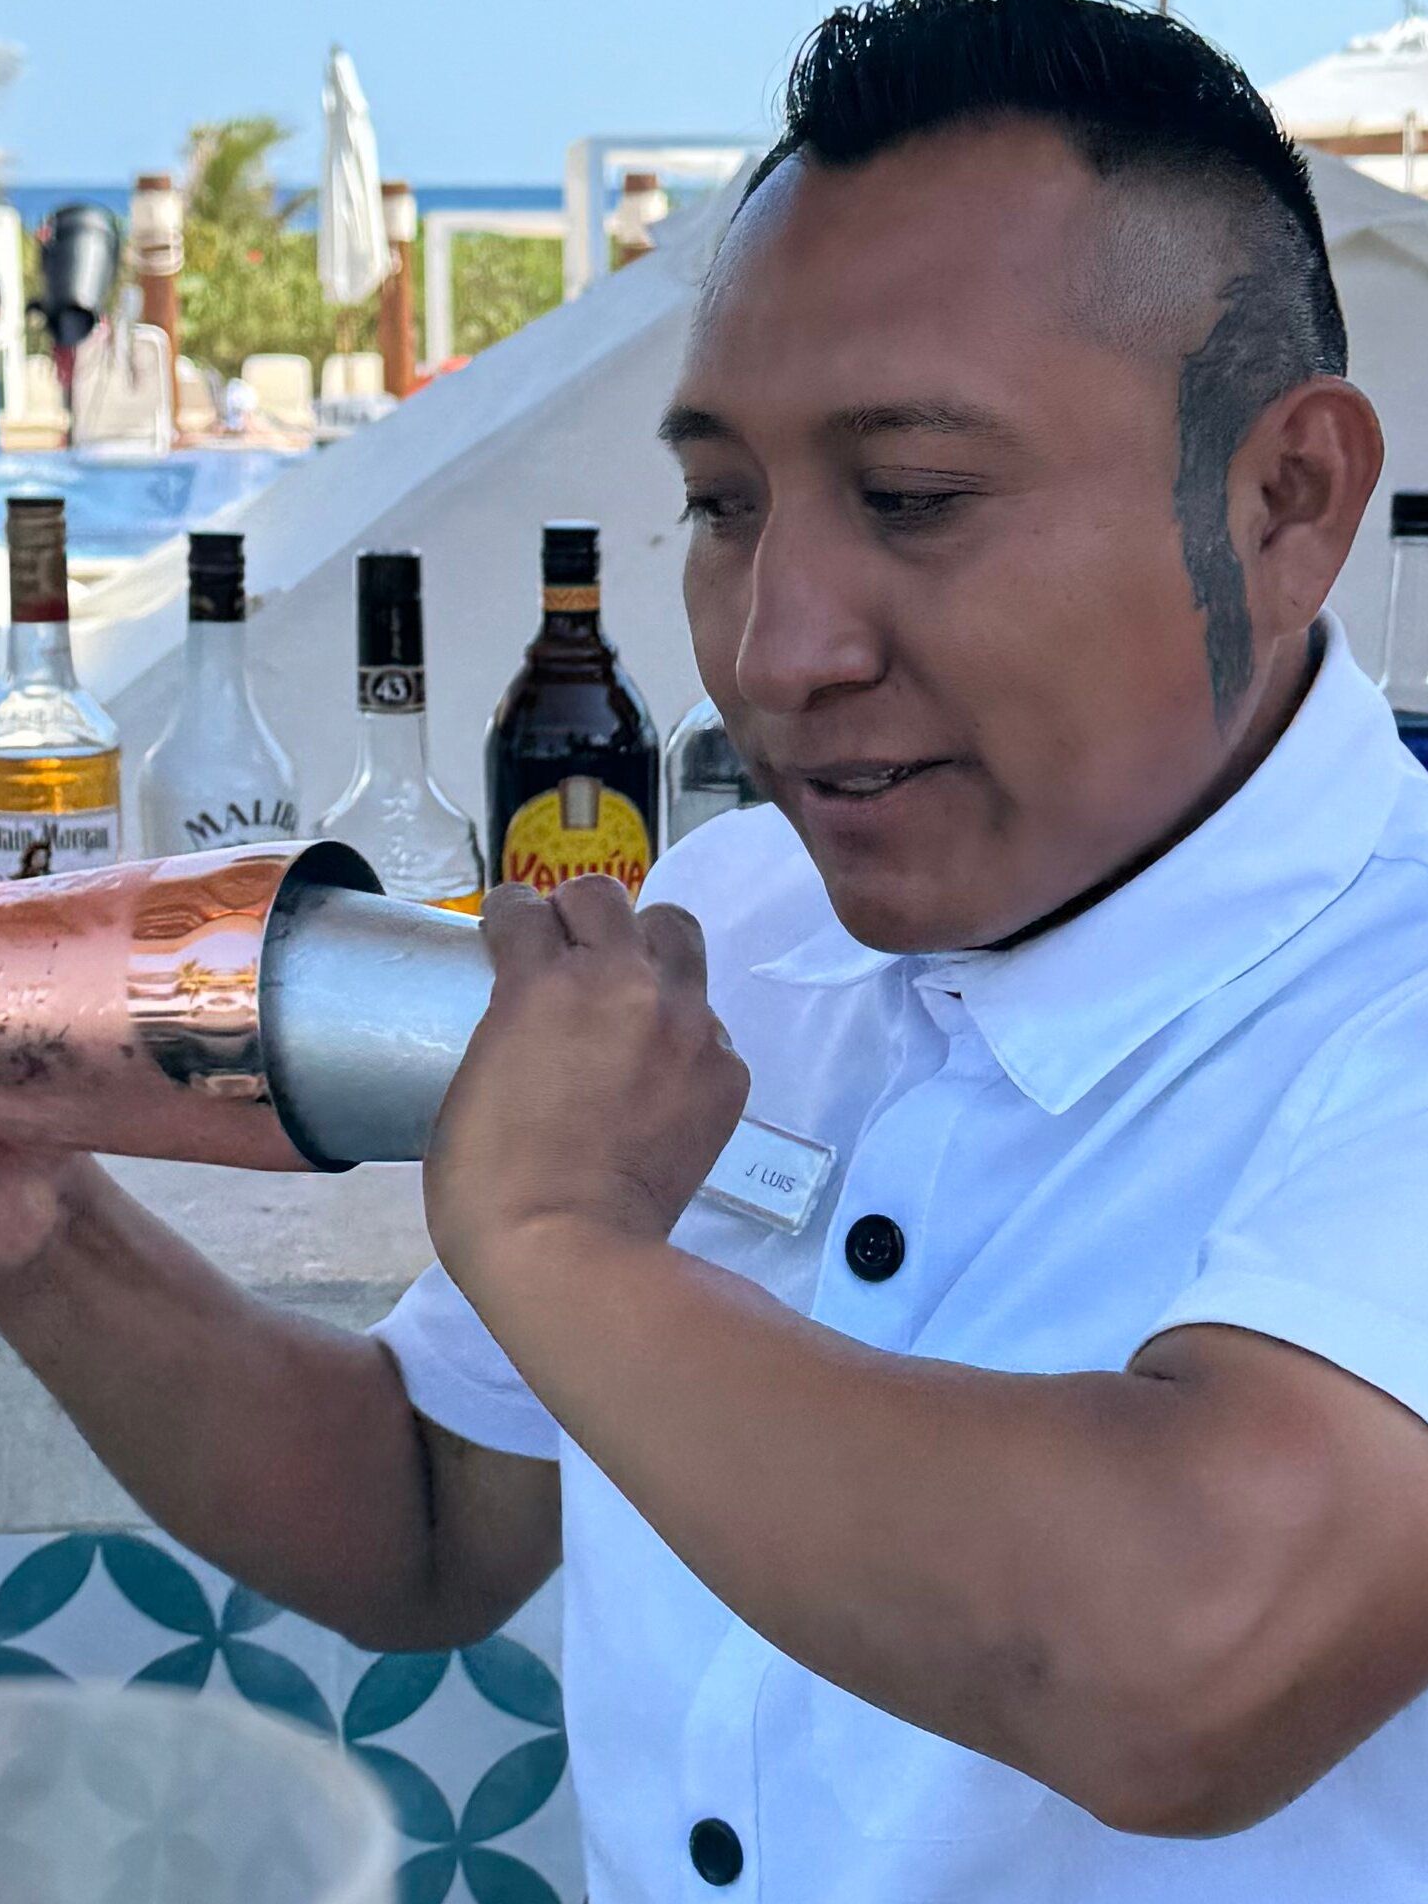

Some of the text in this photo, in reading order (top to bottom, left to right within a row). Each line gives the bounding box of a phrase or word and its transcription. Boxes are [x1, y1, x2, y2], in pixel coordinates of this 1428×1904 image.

[42, 819, 109, 856] Morgan
[184, 799, 297, 849] MALIB
[760, 1167, 797, 1194] LUIS
